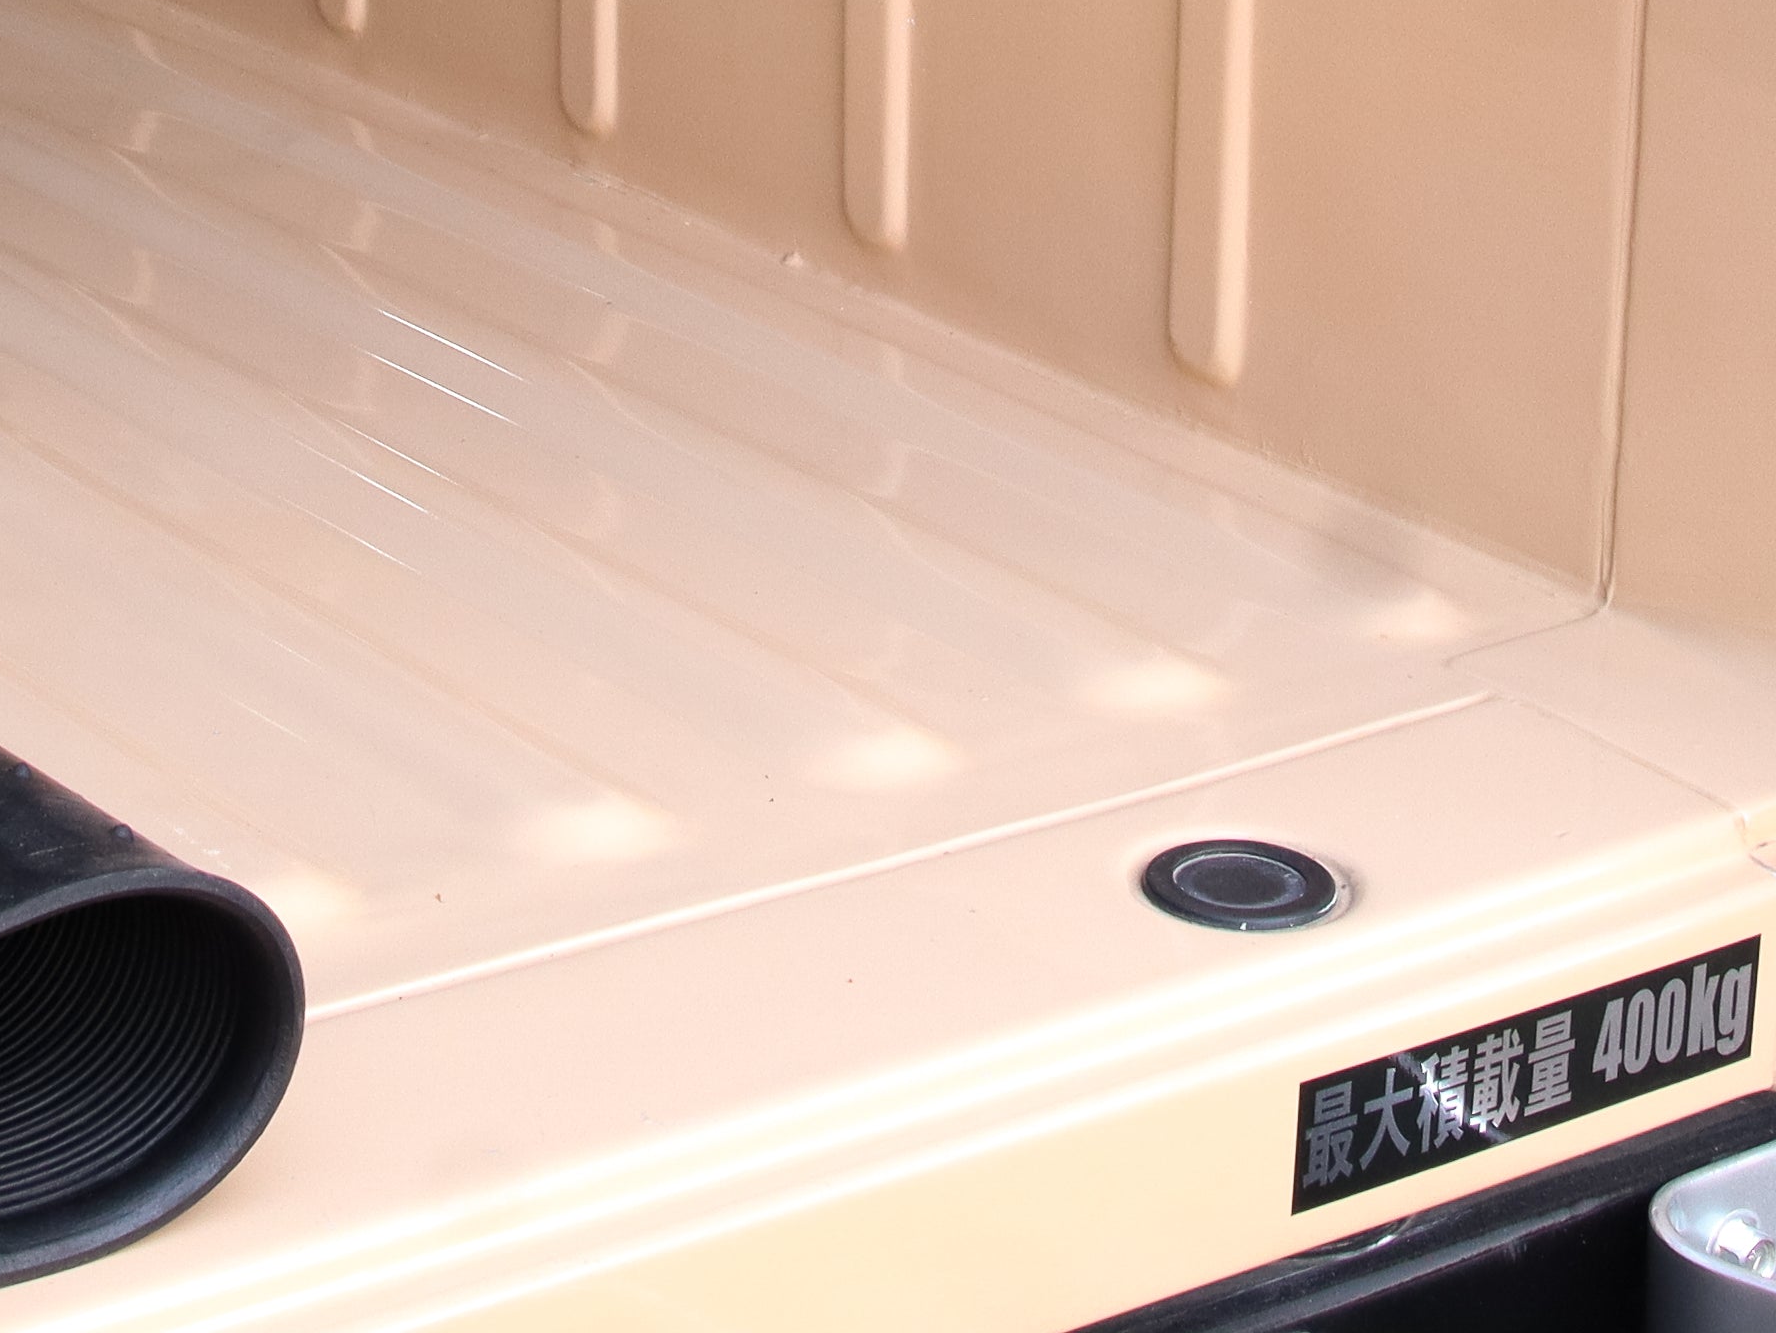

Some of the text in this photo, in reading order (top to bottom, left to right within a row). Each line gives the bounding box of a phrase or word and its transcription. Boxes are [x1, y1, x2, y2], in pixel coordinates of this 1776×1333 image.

[1302, 962, 1753, 1188] 最大積載量 400kg
